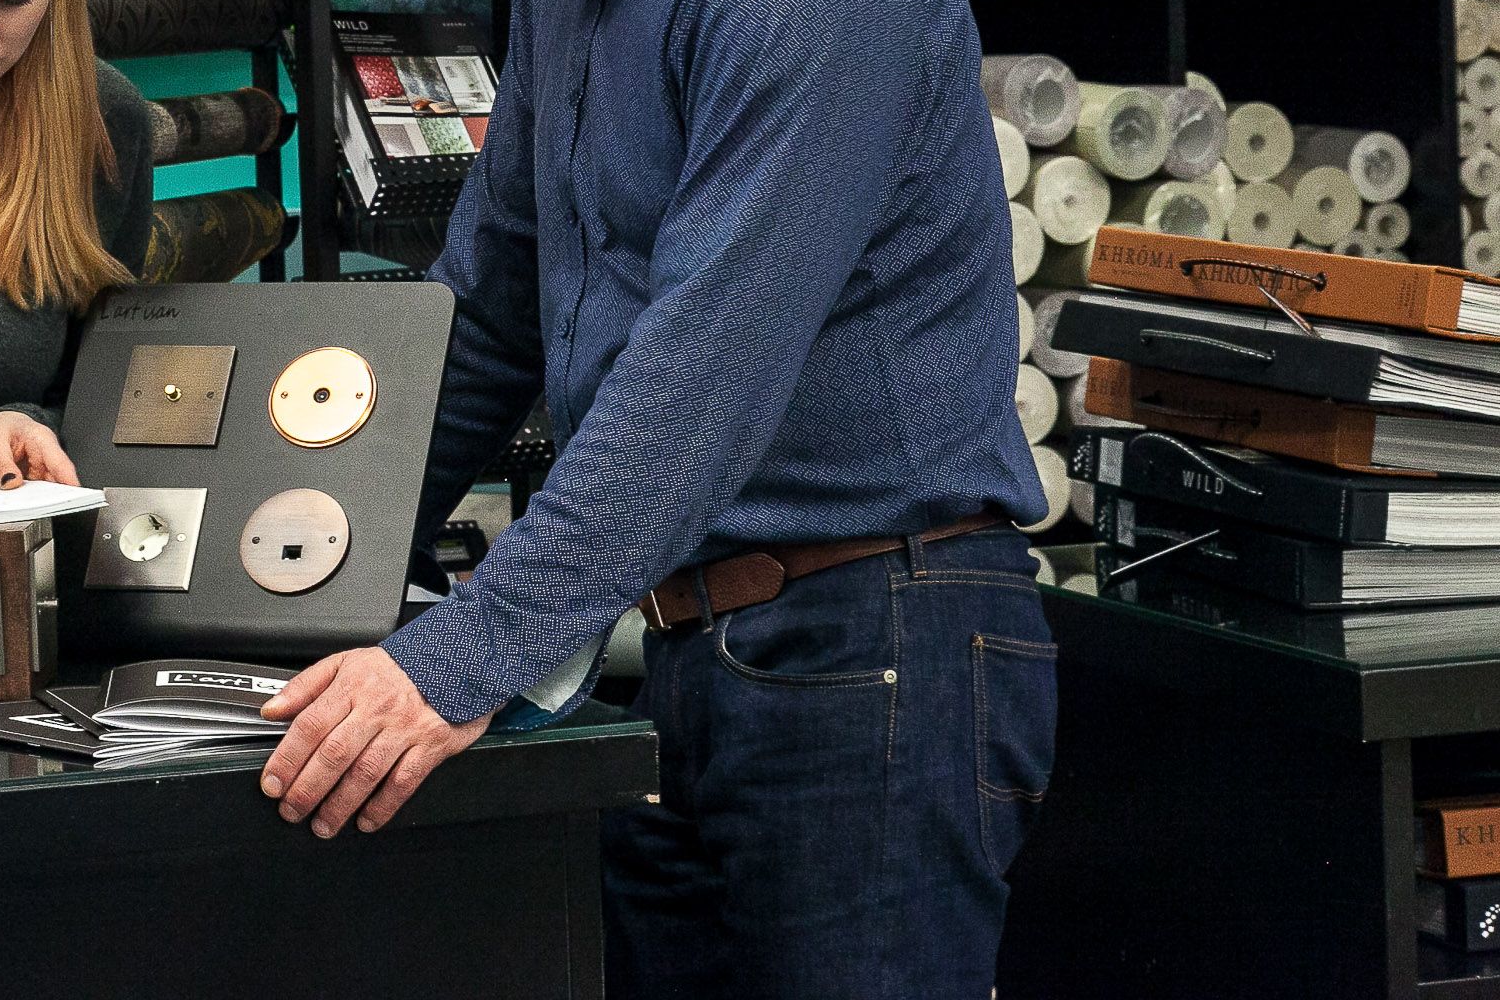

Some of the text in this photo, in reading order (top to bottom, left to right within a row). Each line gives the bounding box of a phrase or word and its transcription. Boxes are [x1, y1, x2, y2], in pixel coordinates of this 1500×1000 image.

[332, 19, 369, 32] WILD
[1182, 470, 1226, 496] WILD
[173, 673, 283, 690] L'artis
[1456, 824, 1496, 846] KH
